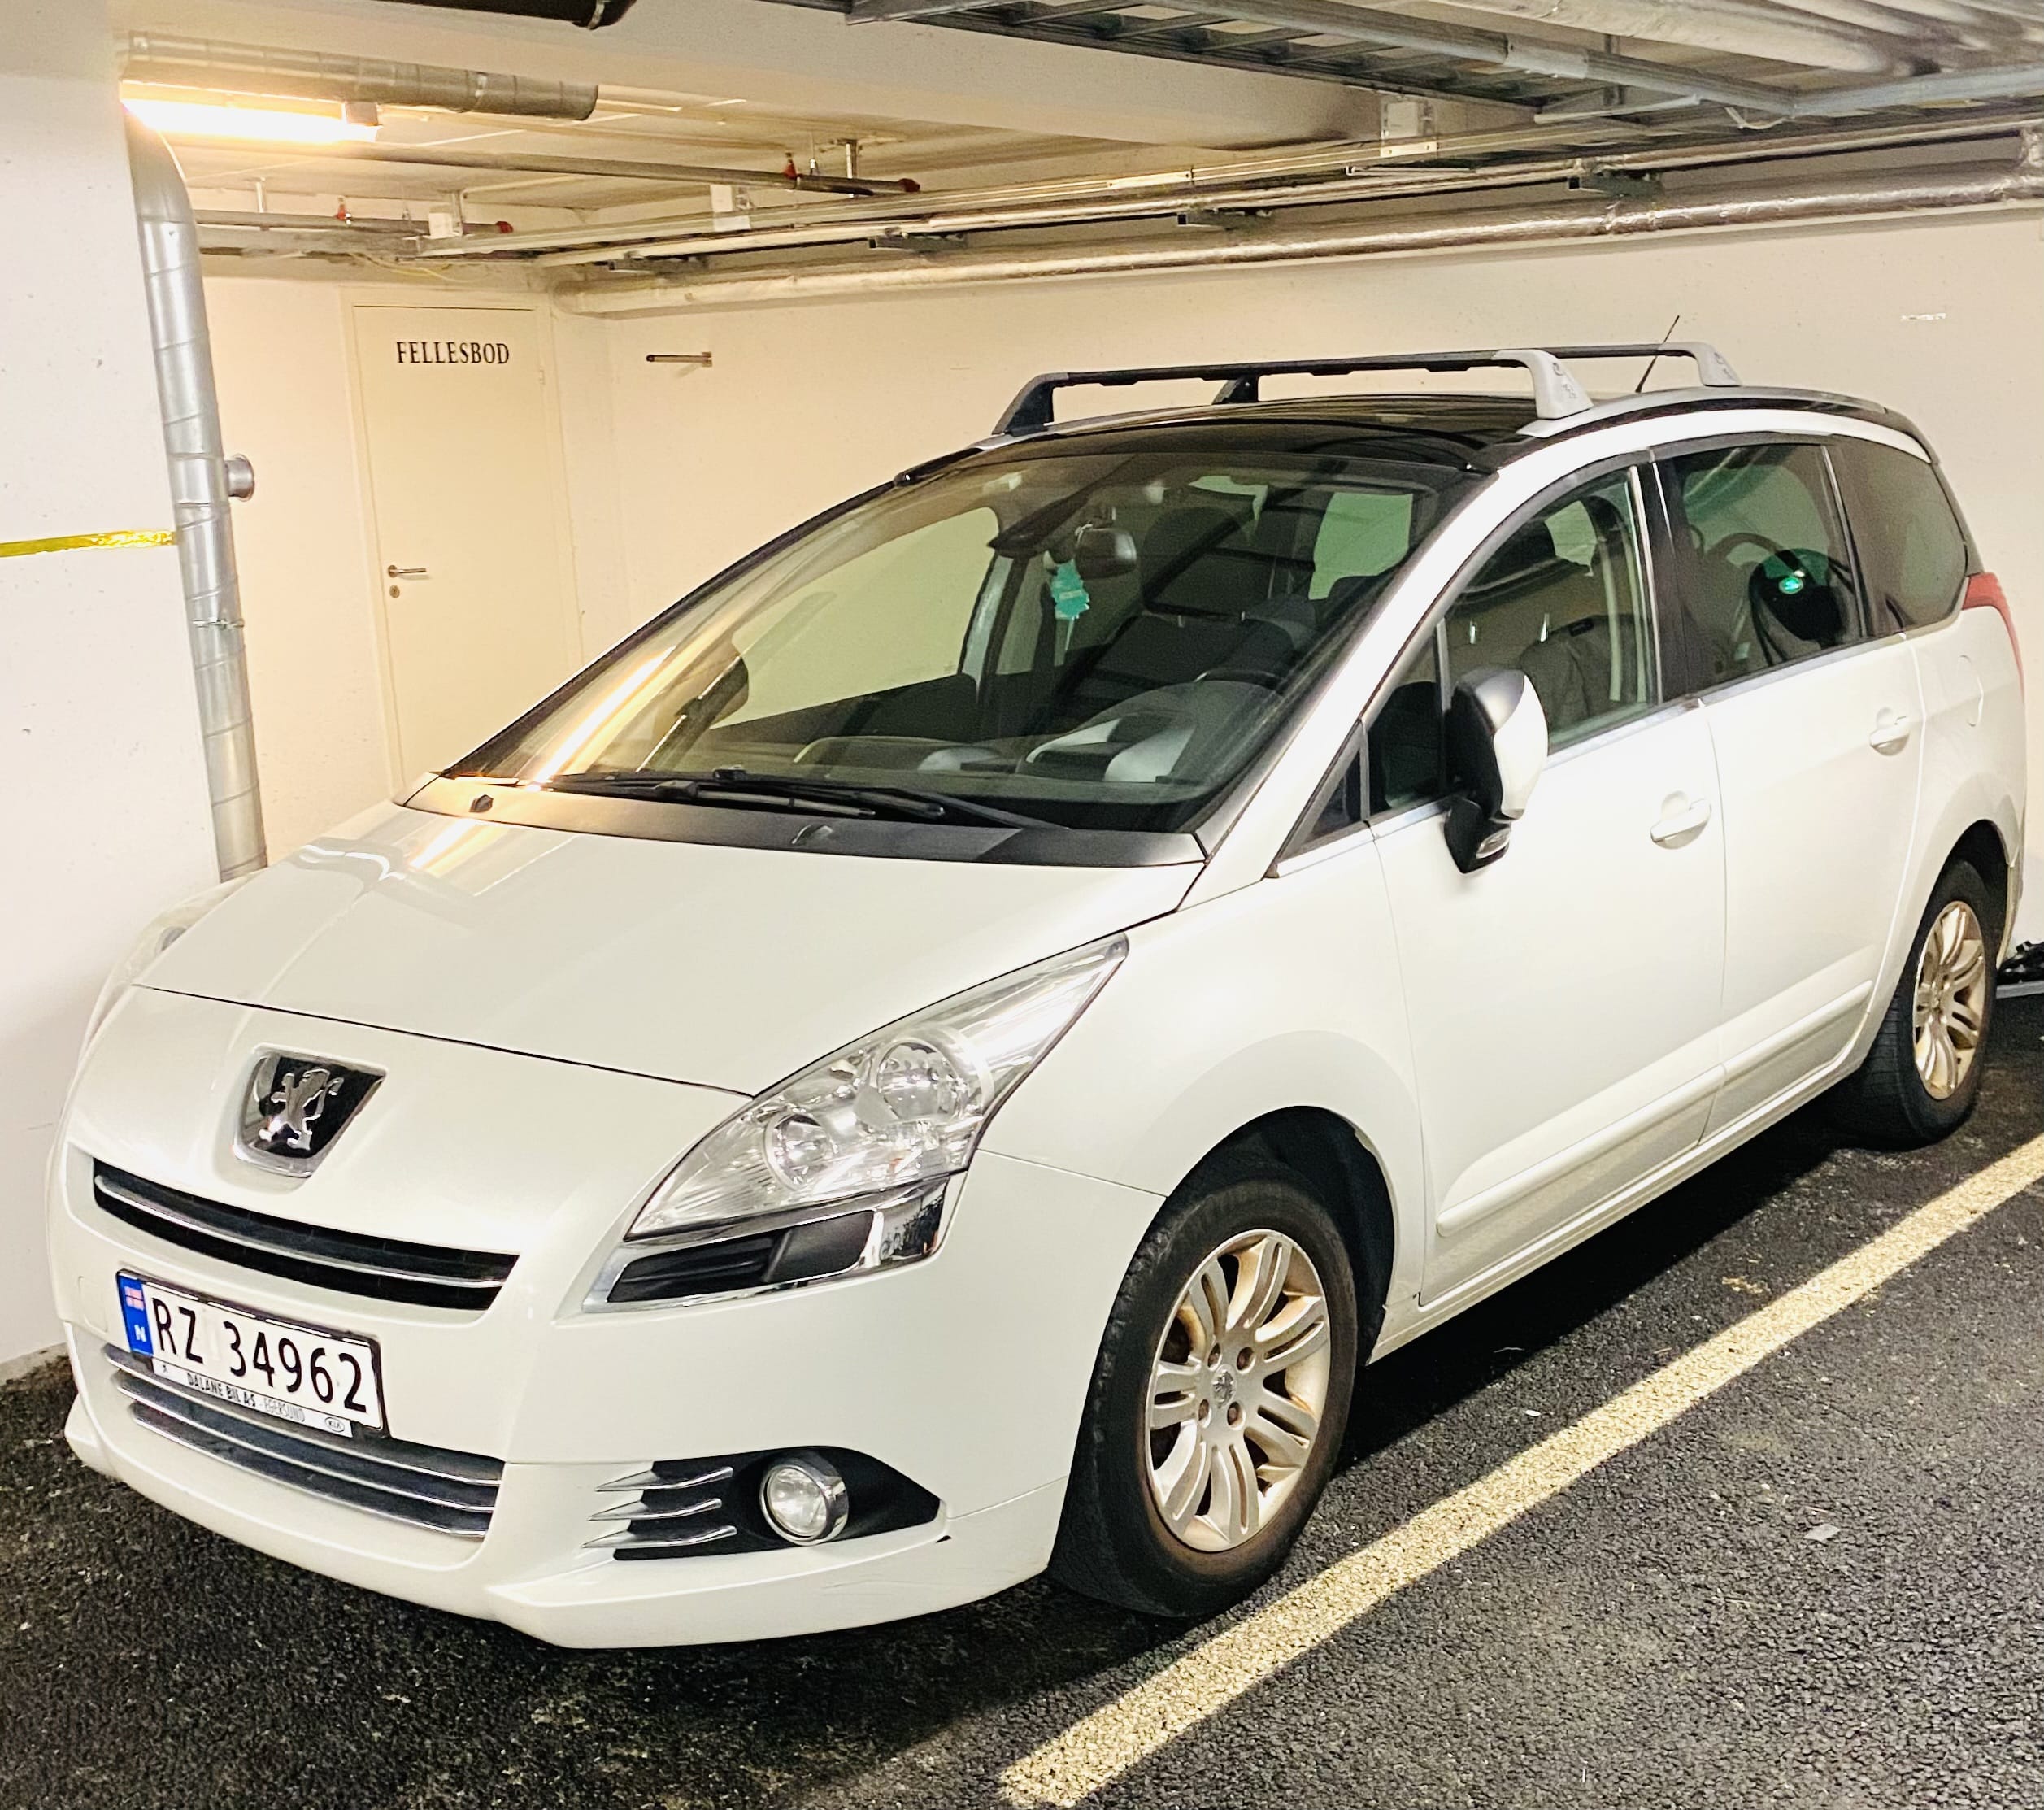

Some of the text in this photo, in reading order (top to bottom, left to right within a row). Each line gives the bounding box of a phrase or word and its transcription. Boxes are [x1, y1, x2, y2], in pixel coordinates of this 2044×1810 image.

[396, 342, 509, 363] FELLESBOD
[136, 1325, 147, 1342] N
[153, 1298, 367, 1413] RZ 34962
[187, 1373, 224, 1397] DALANE
